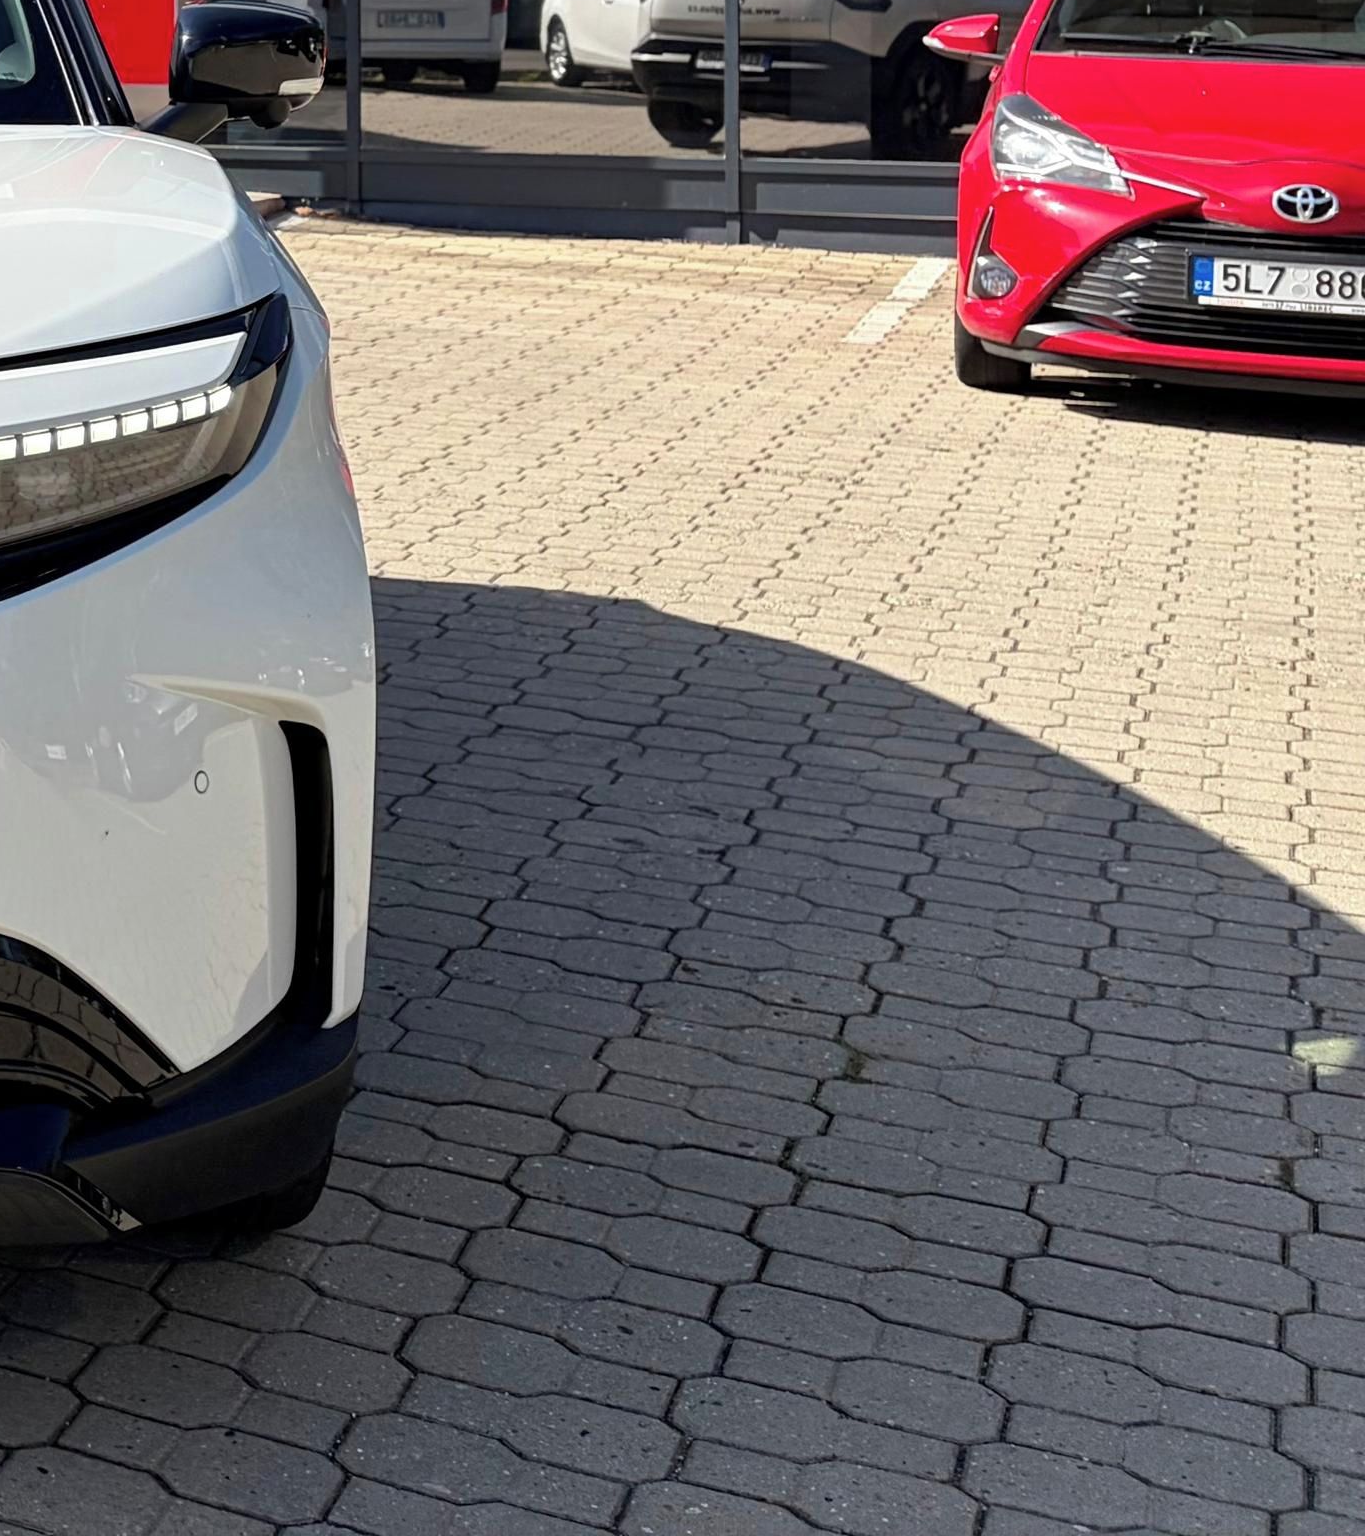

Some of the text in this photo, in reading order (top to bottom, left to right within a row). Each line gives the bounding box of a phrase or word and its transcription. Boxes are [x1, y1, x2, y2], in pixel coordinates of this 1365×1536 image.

[1194, 279, 1212, 291] CZ
[1222, 264, 1365, 300] 5L7 88
